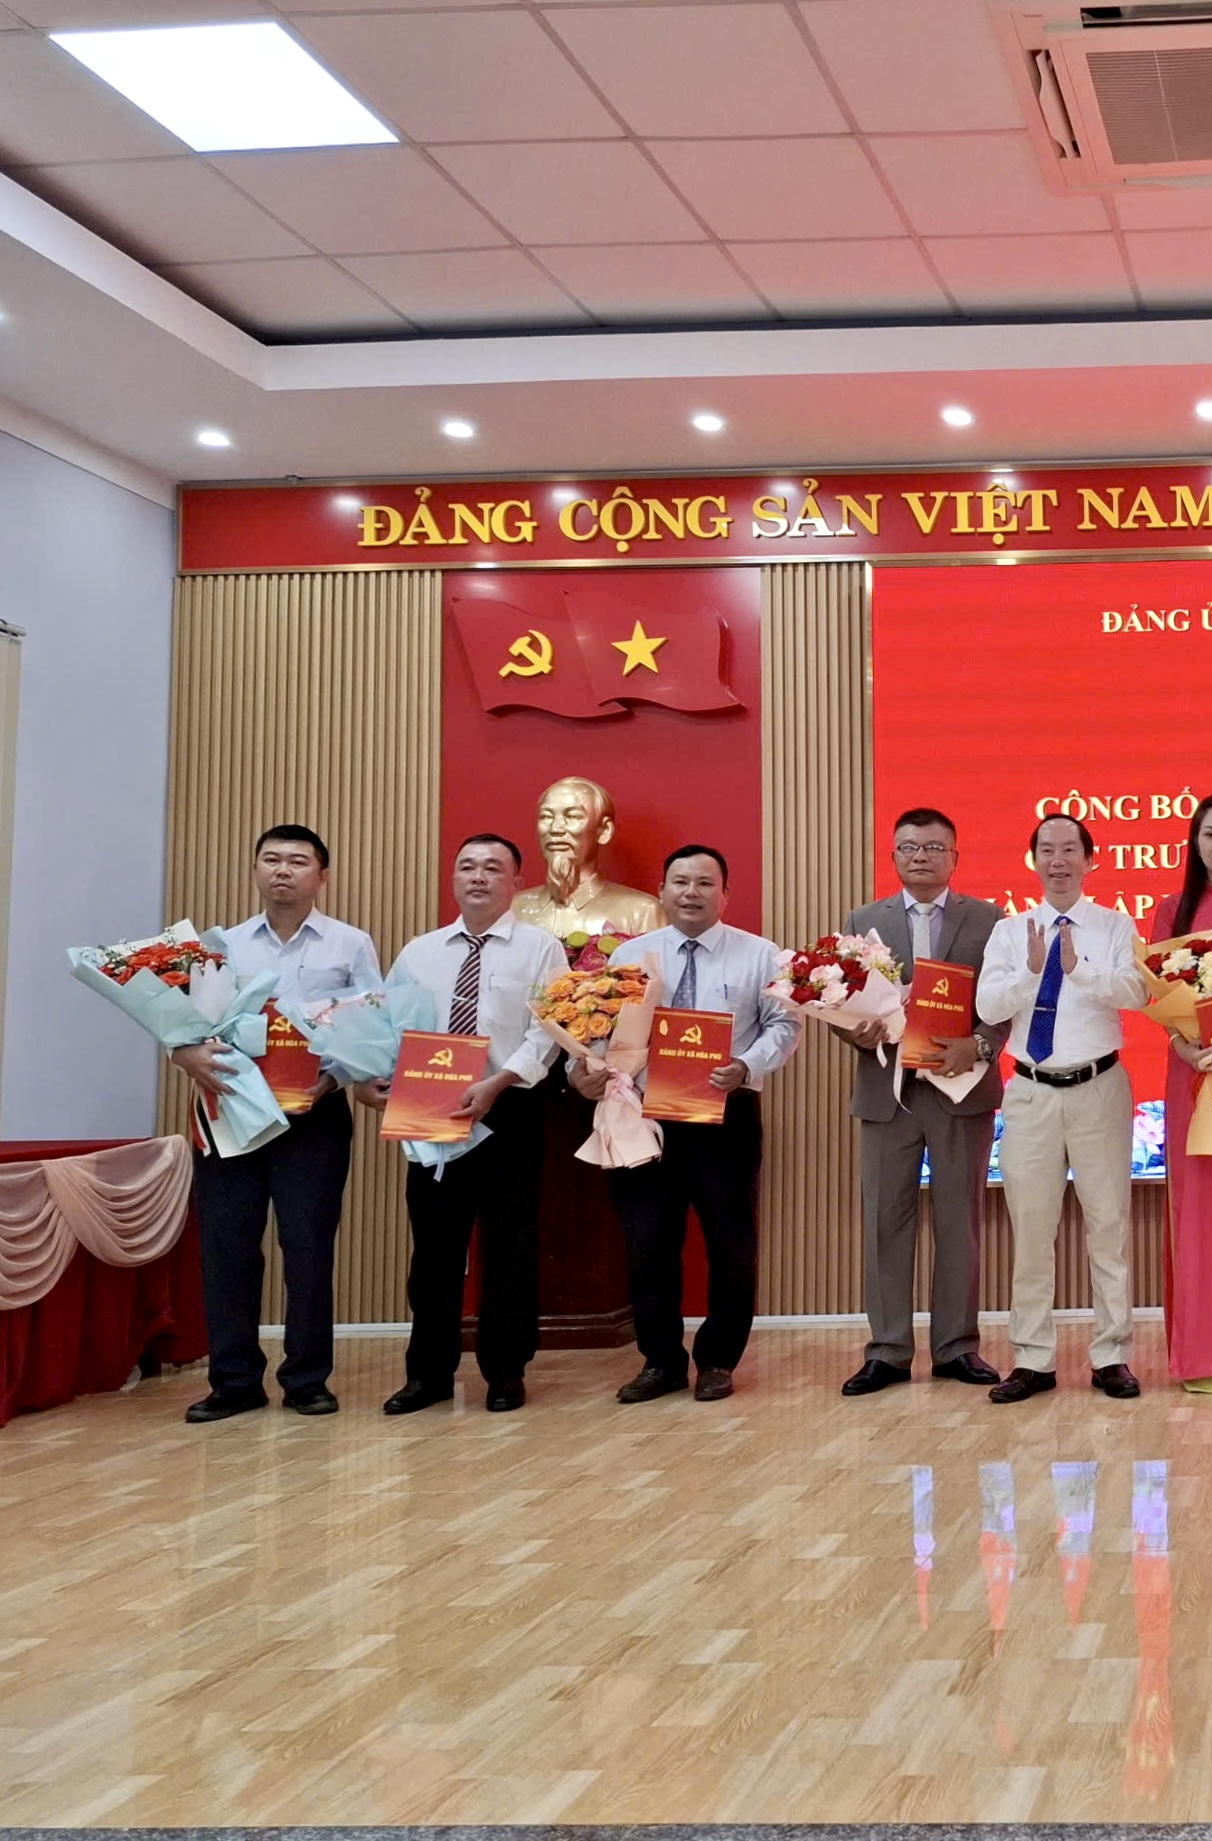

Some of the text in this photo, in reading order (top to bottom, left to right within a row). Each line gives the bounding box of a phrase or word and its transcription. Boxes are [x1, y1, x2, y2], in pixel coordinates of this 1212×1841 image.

[357, 488, 538, 548] ĐẢNG
[559, 486, 735, 553] CỘNG
[752, 478, 882, 540] SẢN
[901, 481, 1059, 546] VIỆT
[1101, 604, 1191, 633] ĐẢNG
[1035, 789, 1140, 821] CÔNG
[1150, 786, 1200, 819] BỐ
